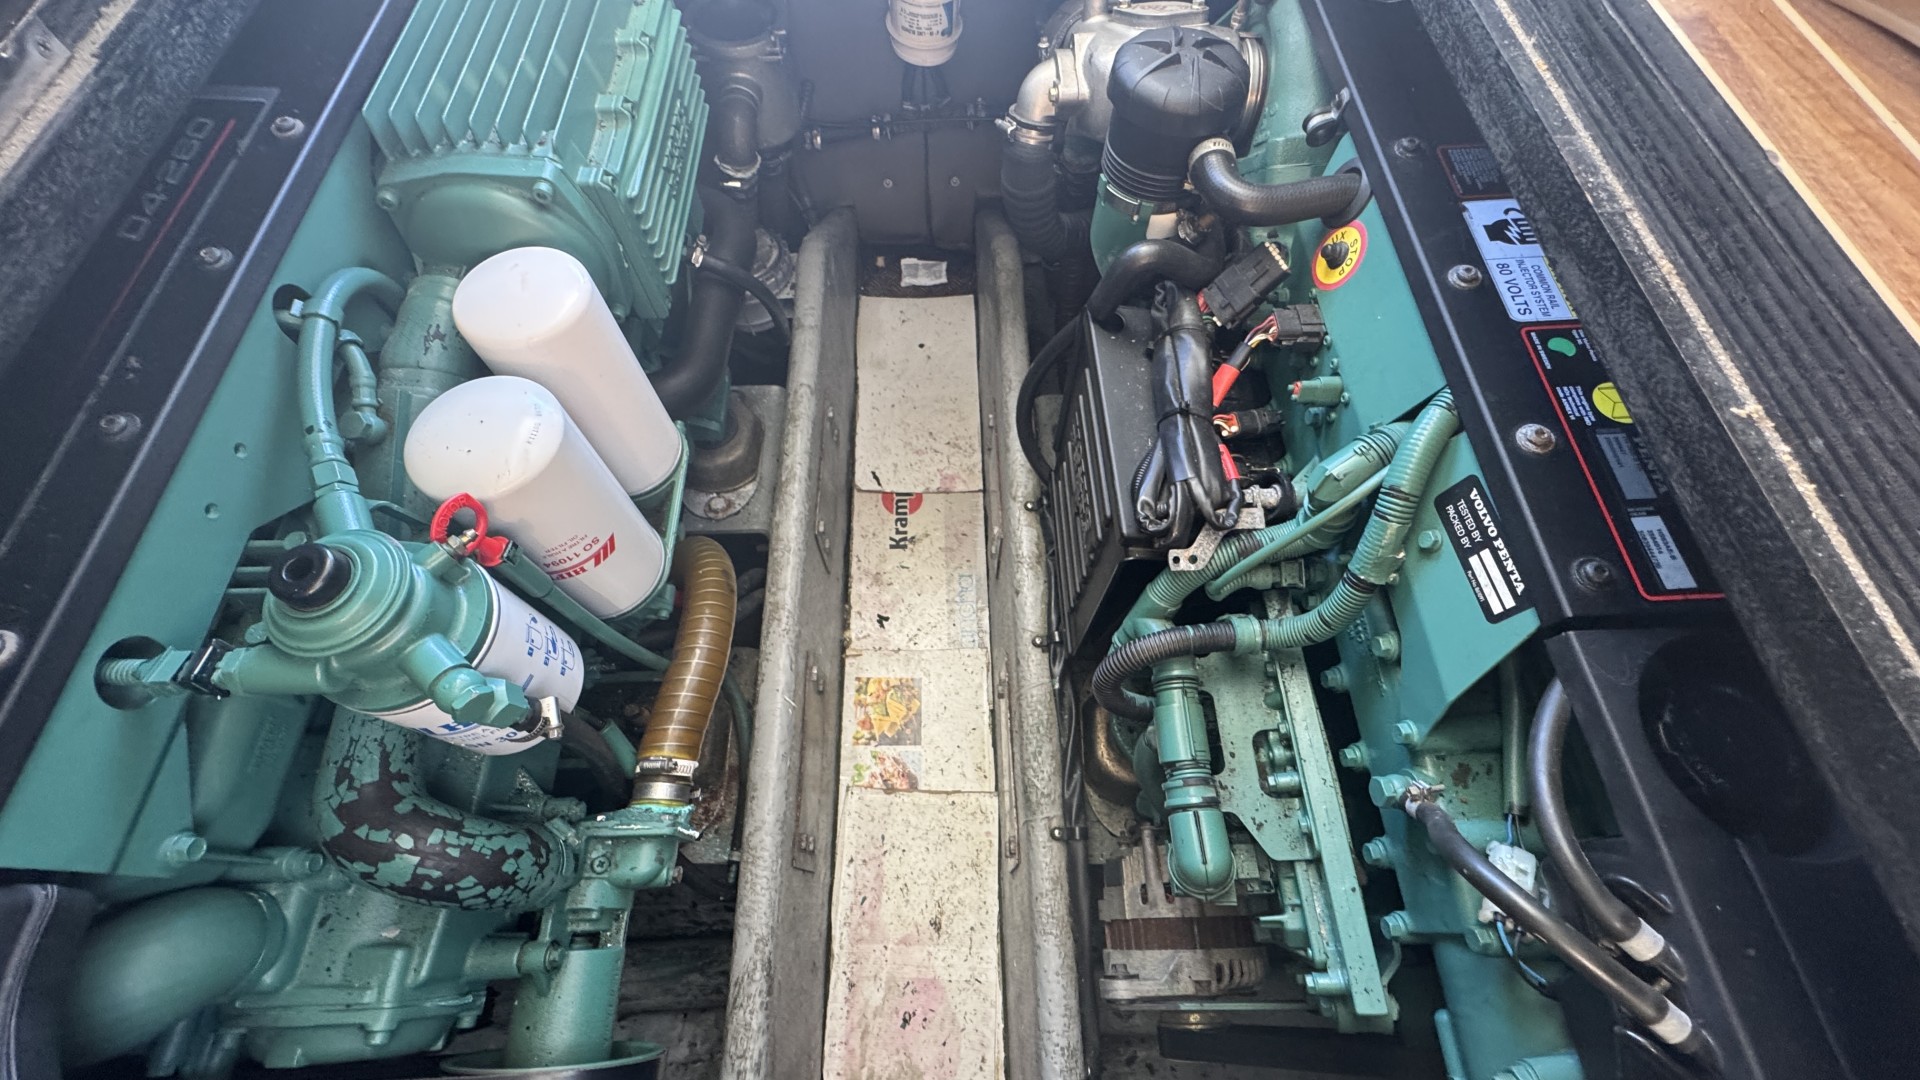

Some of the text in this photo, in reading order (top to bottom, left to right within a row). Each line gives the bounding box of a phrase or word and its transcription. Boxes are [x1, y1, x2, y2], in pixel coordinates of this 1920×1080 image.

[1338, 238, 1358, 276] STOP
[1495, 261, 1532, 316] 80 VOLTS
[1514, 258, 1551, 318] INJECTOR SYSTEM
[1530, 264, 1551, 292] COMMON
[1545, 293, 1560, 309] RAIL
[1529, 331, 1540, 344] MADE
[1538, 350, 1551, 369] SWEDEN
[1588, 349, 1597, 361] Penta
[1560, 398, 1572, 414] ANNEX
[1579, 395, 1590, 411] engine
[1586, 411, 1595, 421] type
[1630, 435, 1668, 495] PENTA
[433, 496, 467, 541] MOTOR
[1444, 504, 1472, 549] PACKED BY
[1454, 498, 1483, 543] TESTED BY
[1467, 487, 1526, 595] VOLVO PENTA
[542, 536, 600, 568] SO 11094
